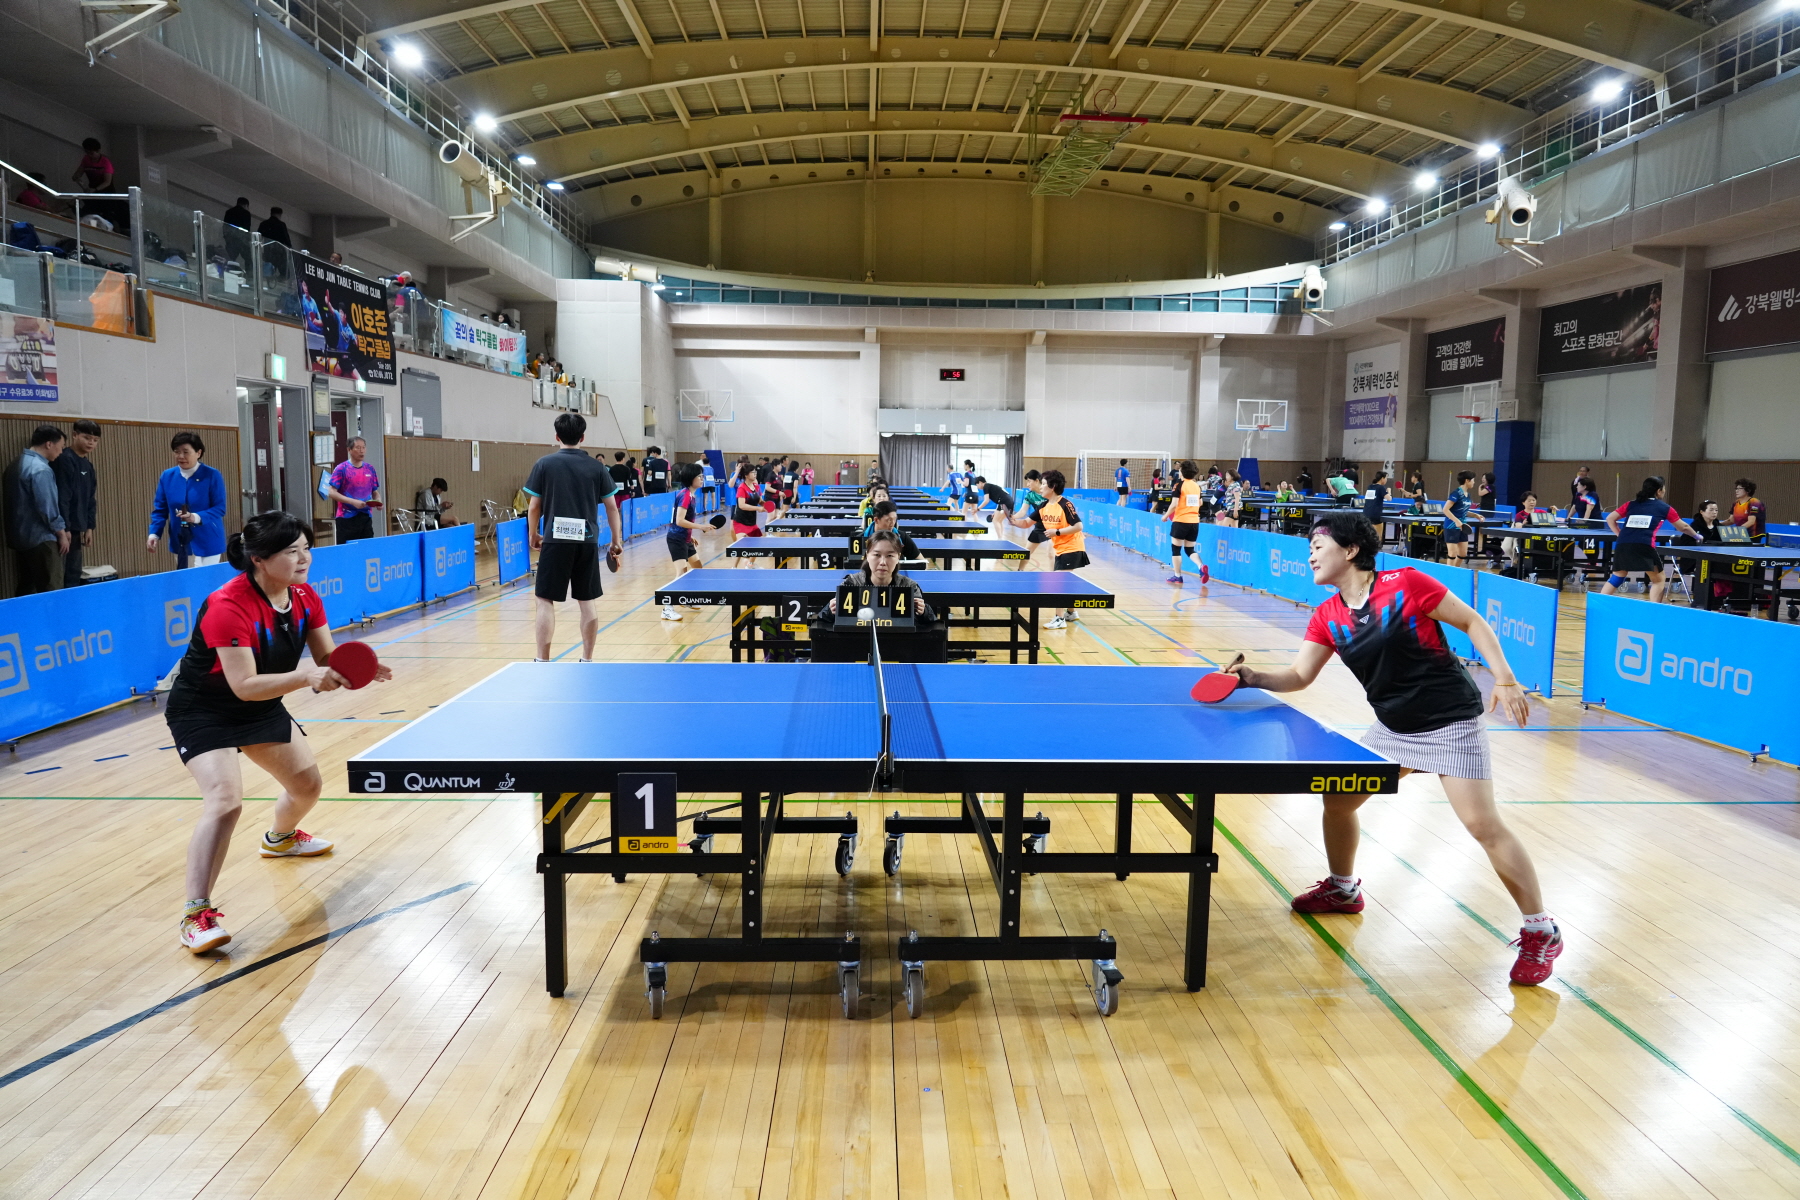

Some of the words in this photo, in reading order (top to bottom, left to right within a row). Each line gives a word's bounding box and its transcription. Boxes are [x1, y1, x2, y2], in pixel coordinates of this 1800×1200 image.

[305, 262, 316, 276] LEE
[326, 271, 336, 284] JUN
[336, 274, 352, 290] TABLE
[352, 280, 369, 296] TENNIS
[369, 286, 382, 300] CLUB
[350, 302, 388, 336] 이호준
[1553, 319, 1578, 337] 최고의
[455, 321, 468, 342] 꿈의
[468, 326, 475, 344] 숲
[475, 328, 498, 351] 탁구클럽
[1561, 335, 1586, 353] 스포츠
[1587, 330, 1624, 349] 문화공간
[357, 334, 391, 360] 탁구클럽
[1435, 343, 1453, 358] 고객의
[1453, 340, 1472, 355] 건강한
[1441, 357, 1458, 372] 미래를
[1459, 354, 1484, 370] 열어가는
[852, 539, 860, 554] 6
[1584, 538, 1595, 549] 14
[447, 548, 467, 568] andro
[820, 552, 831, 568] 3
[1228, 545, 1251, 564] andro
[383, 560, 414, 582] andro
[1282, 557, 1306, 577] andro
[311, 575, 343, 598] ndro
[678, 595, 712, 605] QUANTUM
[843, 592, 854, 614] 4
[862, 590, 870, 606] 0
[880, 591, 886, 607] 1
[895, 592, 906, 615] 4
[1073, 598, 1107, 608] andro
[788, 600, 802, 622] 2
[1502, 614, 1536, 647] andro
[35, 629, 114, 672] andro
[1660, 652, 1753, 696] andro
[403, 772, 481, 792] QUANTUM
[1310, 773, 1381, 792] andro
[634, 782, 655, 830] 1
[642, 841, 669, 849] andro
